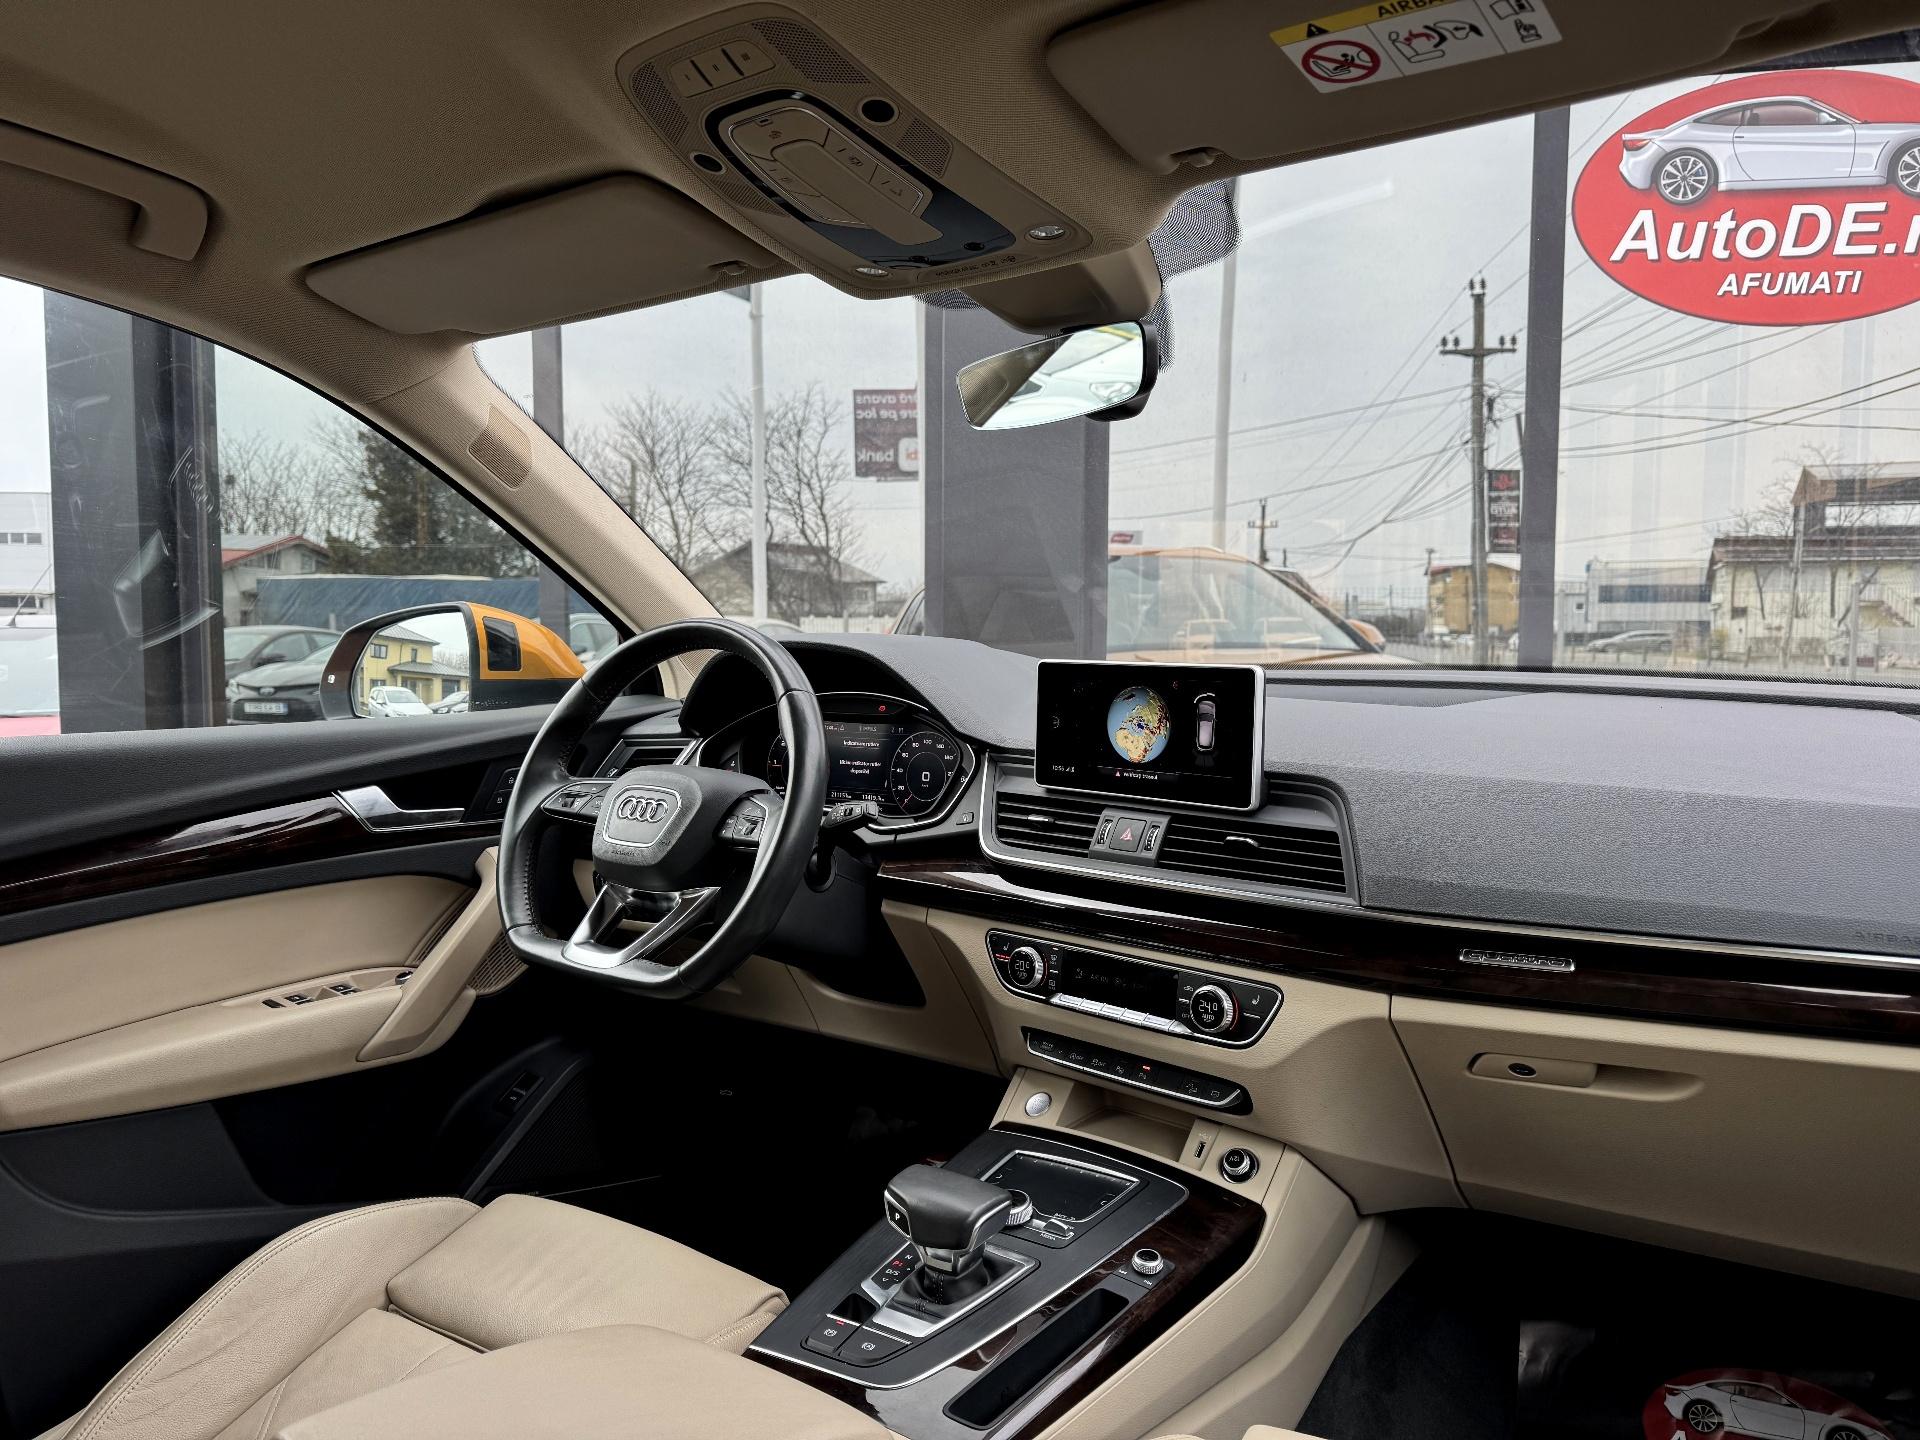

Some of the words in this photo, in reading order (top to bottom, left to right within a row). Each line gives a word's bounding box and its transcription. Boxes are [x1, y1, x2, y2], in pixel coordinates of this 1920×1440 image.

[1716, 270, 1863, 296] AFUMATI
[921, 771, 931, 782] 0
[1467, 950, 1567, 970] quattro
[1198, 999, 1218, 1013] 24.0
[1201, 1013, 1215, 1021] AUTO
[895, 1212, 901, 1221] P
